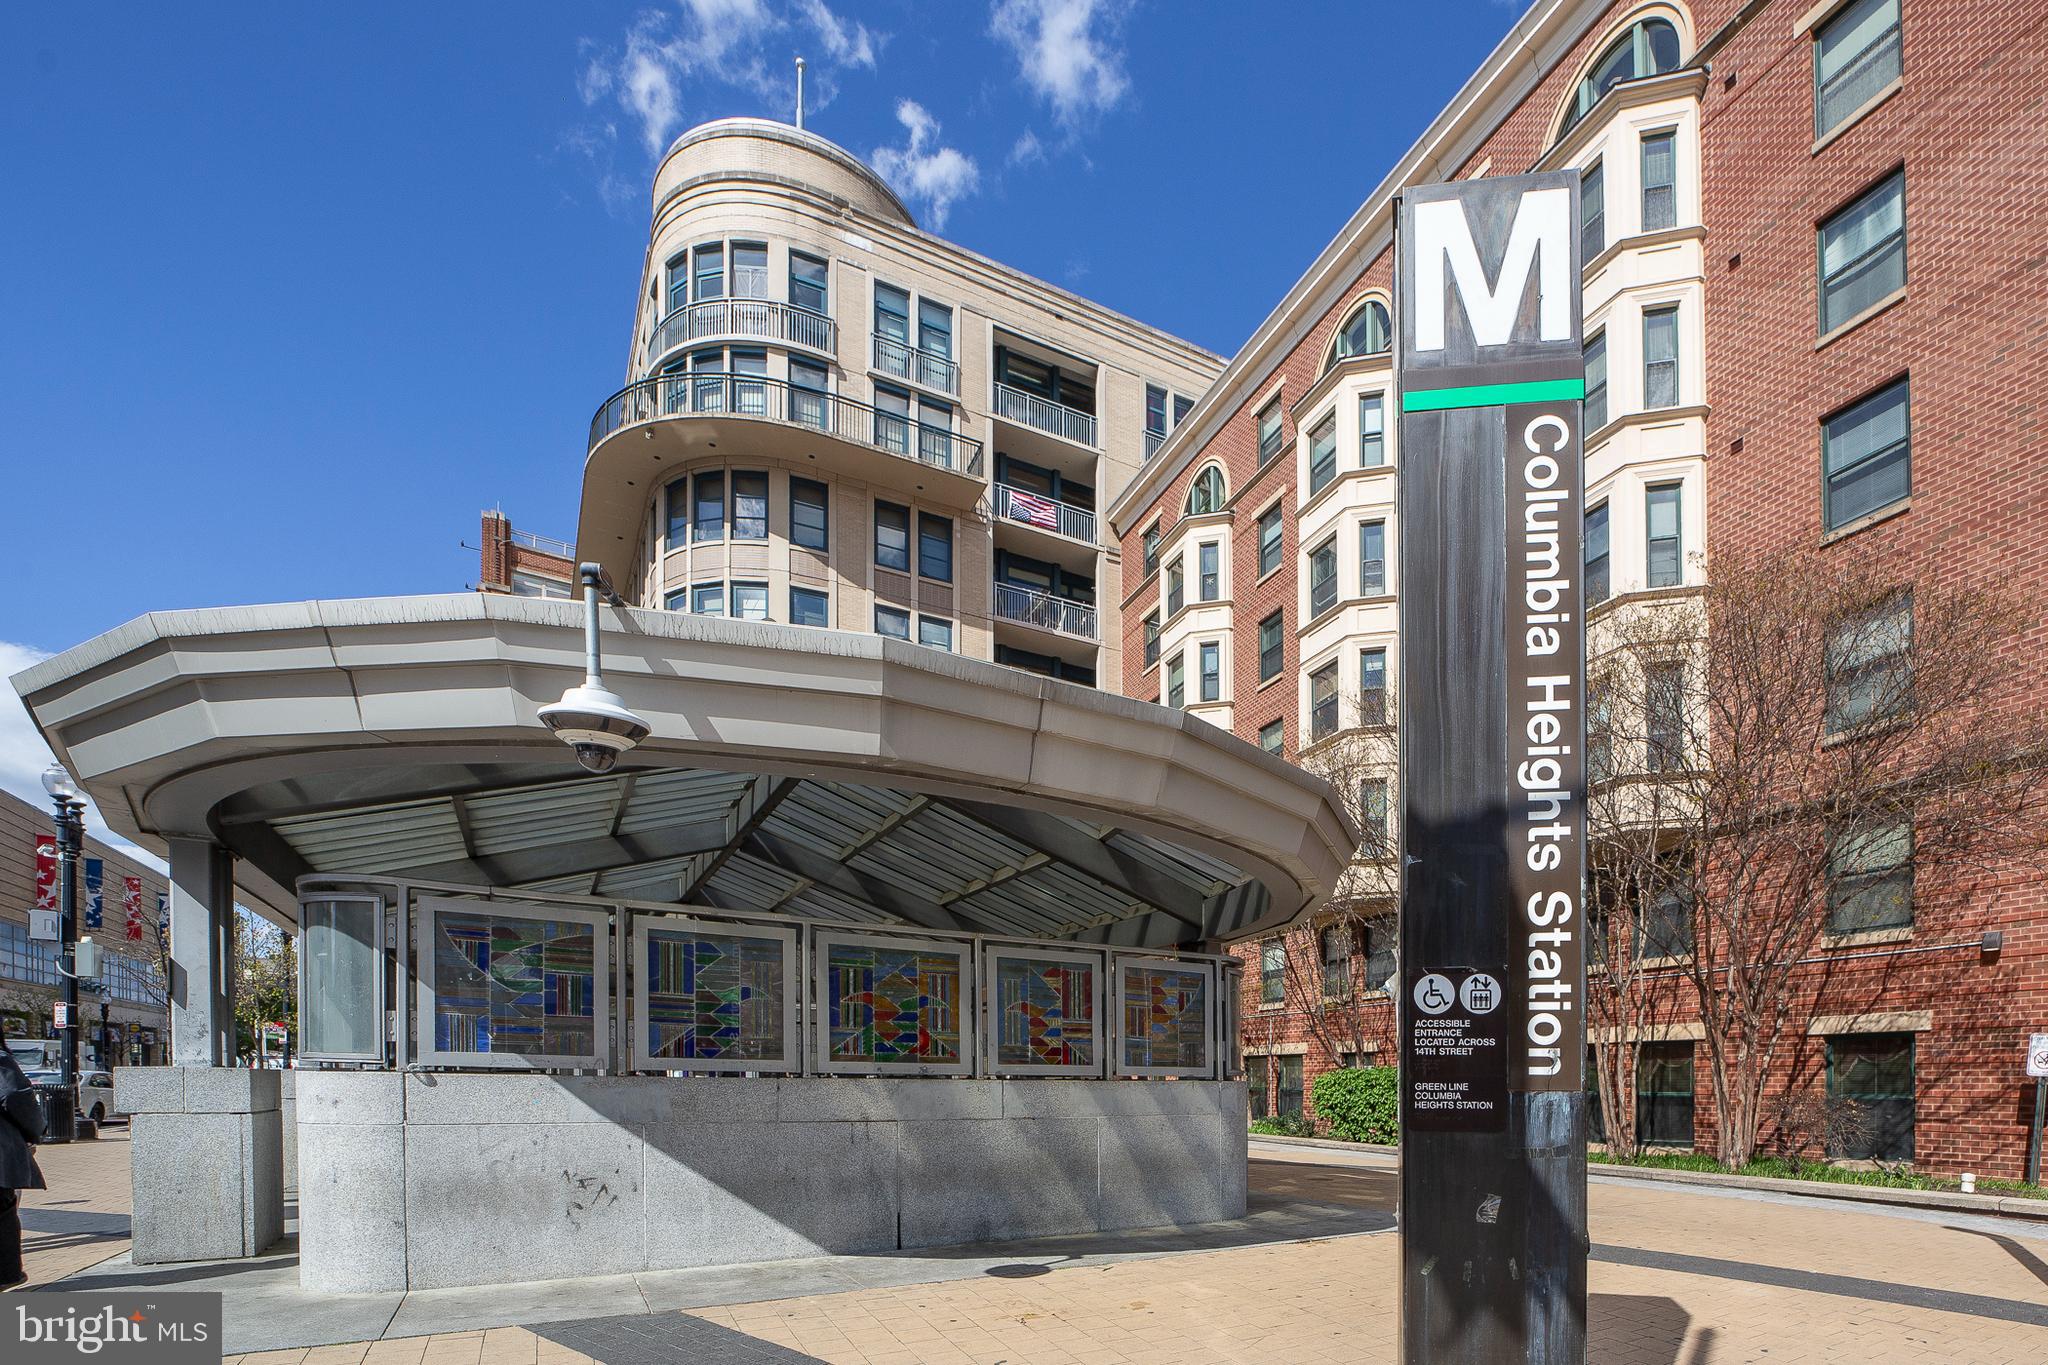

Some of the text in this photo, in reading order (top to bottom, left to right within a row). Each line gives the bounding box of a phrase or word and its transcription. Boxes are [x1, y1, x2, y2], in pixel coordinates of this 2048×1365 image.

[1414, 187, 1572, 352] M
[1517, 414, 1573, 1076] Columbia Heights Station
[1414, 1019, 1471, 1028] ACCESSIBLE
[1414, 1028, 1463, 1037] ENTRANCE
[1414, 1038, 1496, 1046] LOCATED ACROSS
[1414, 1047, 1474, 1056] 14TH STREET
[1414, 1082, 1469, 1091] GREEN LINE
[1414, 1091, 1462, 1100] COLUMBIA
[1414, 1101, 1493, 1109] HEIGHTS STATION
